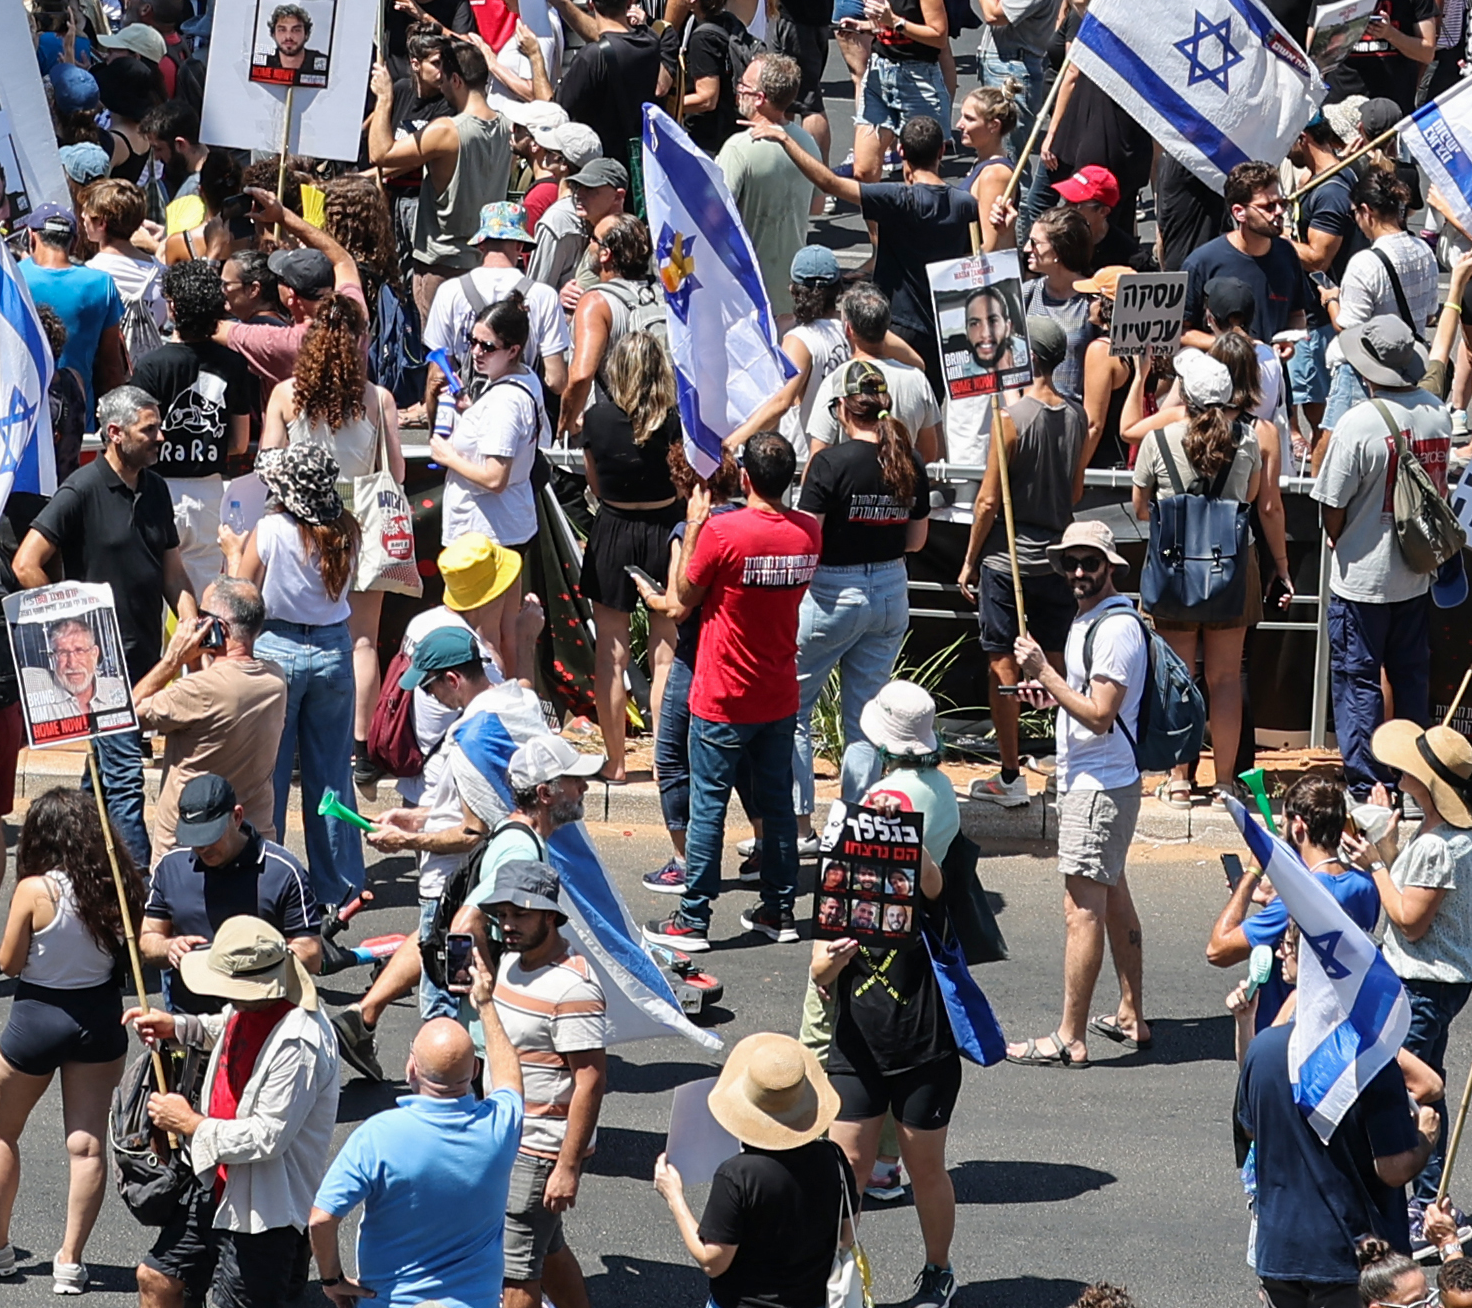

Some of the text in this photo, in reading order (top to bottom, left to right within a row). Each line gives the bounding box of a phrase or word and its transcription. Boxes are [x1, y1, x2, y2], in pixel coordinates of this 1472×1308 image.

[1122, 281, 1186, 316] עסקה
[1112, 315, 1182, 347] עכשיו!
[943, 348, 971, 369] BRING
[945, 365, 964, 383] HIM
[27, 688, 56, 709] BRING
[28, 705, 51, 725] HIM
[32, 714, 89, 740] HOME NOW!
[846, 812, 920, 845] בגללך
[844, 840, 919, 863] הם נרצחו
